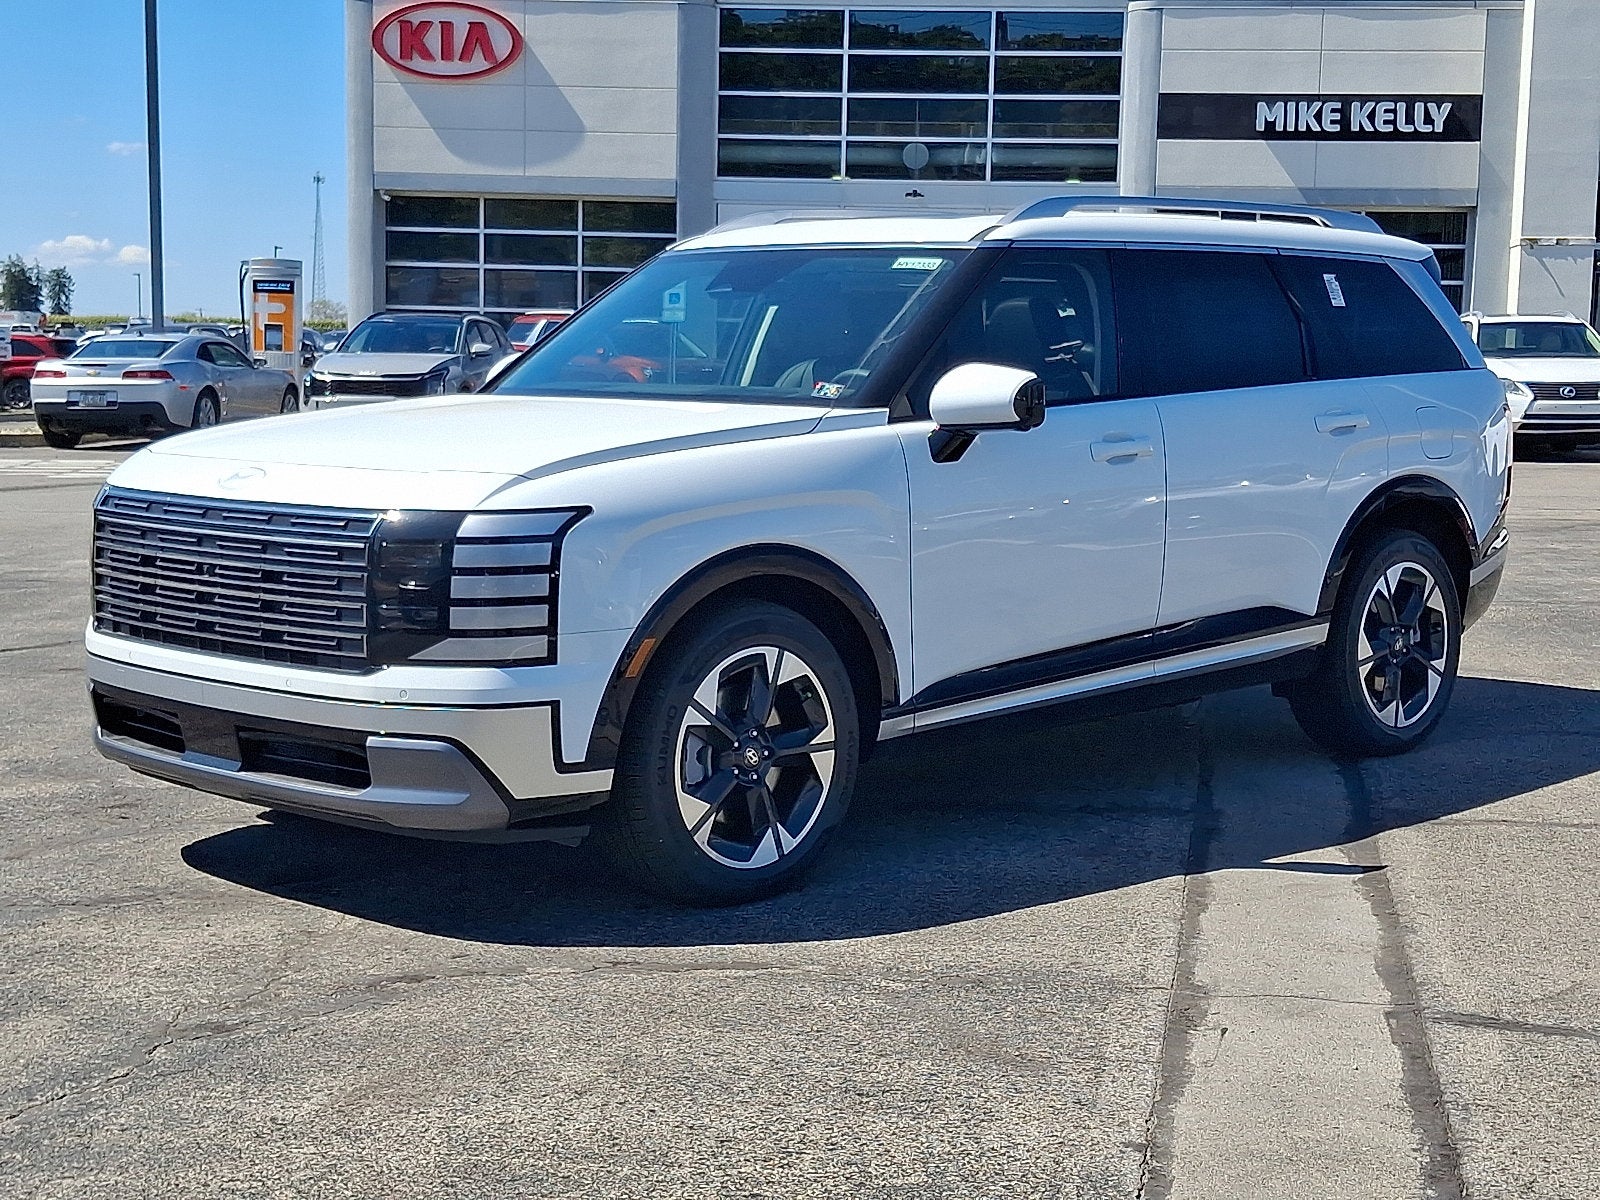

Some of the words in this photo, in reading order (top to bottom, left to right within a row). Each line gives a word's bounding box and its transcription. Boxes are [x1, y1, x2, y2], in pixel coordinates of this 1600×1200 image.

[397, 19, 498, 64] KIA
[1255, 101, 1342, 132] MIKE
[1350, 101, 1452, 133] KELLY
